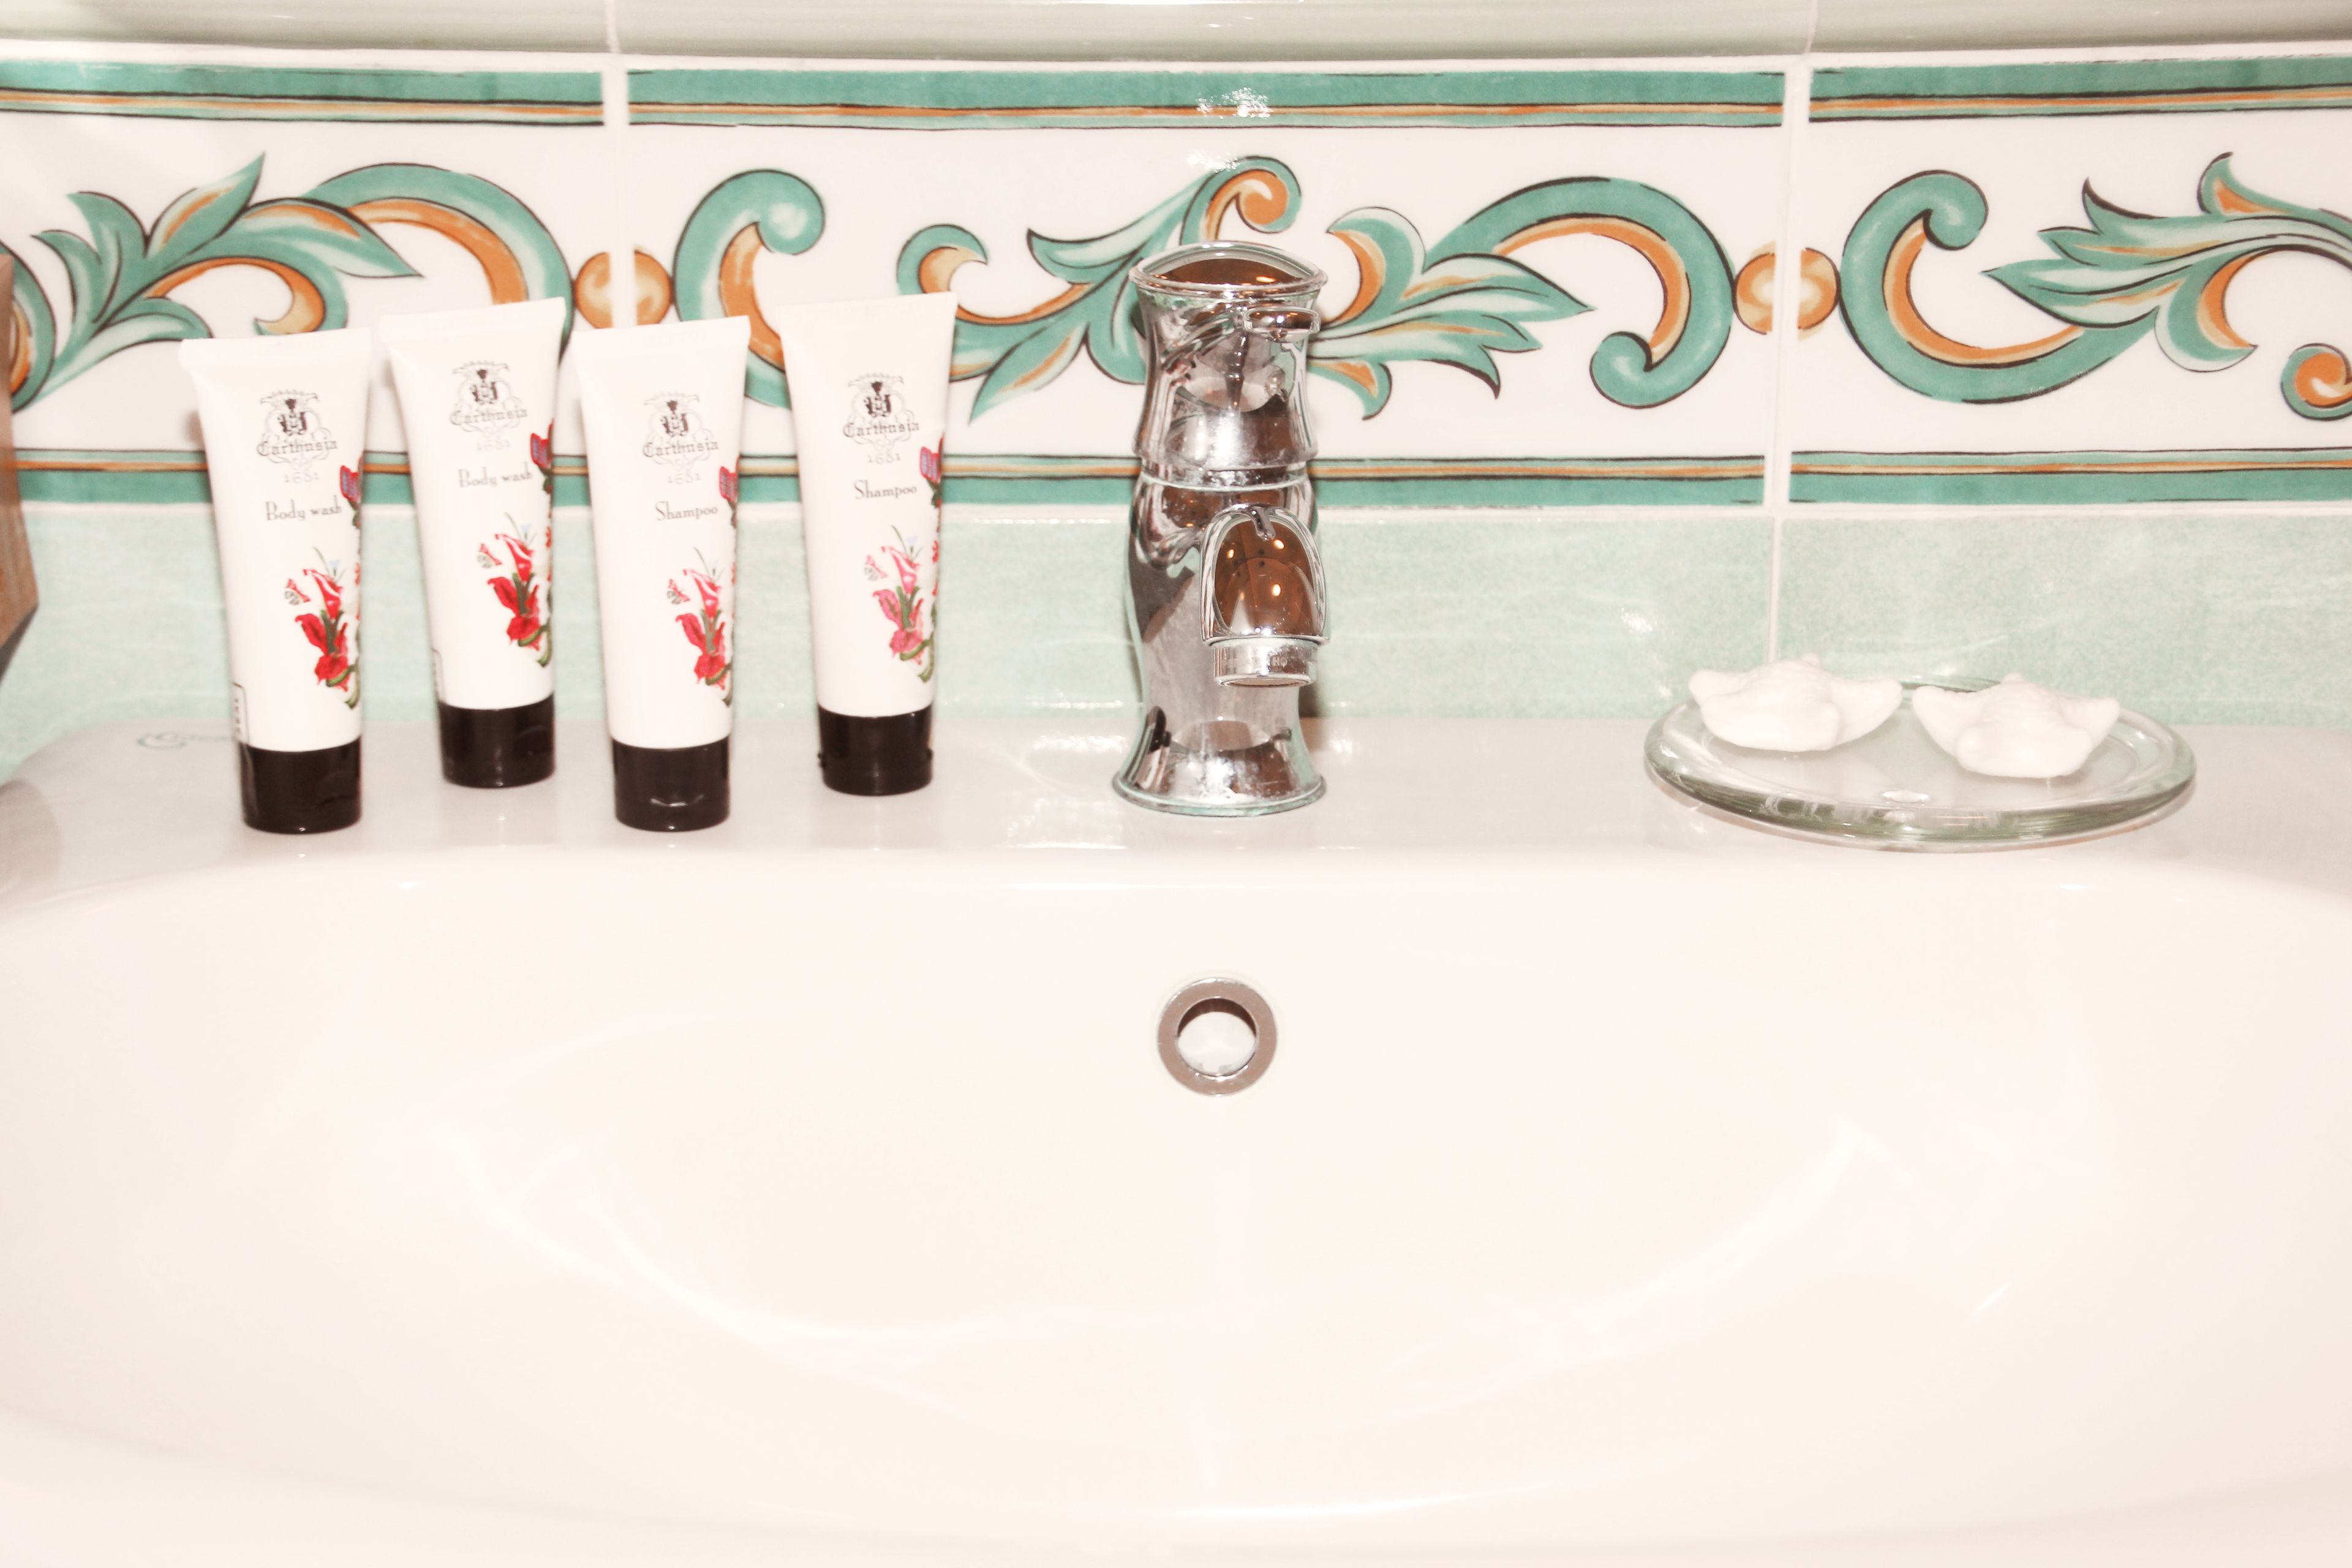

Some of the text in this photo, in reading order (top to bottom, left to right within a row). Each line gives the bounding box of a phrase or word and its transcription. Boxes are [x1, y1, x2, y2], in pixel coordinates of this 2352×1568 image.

[843, 419, 919, 438] Carthusia
[257, 437, 337, 456] Carthusia
[643, 437, 720, 458] Carthusia
[458, 461, 533, 488] Body wash
[853, 479, 918, 500] Shampoo
[265, 494, 342, 521] Body wash
[655, 500, 719, 521] Shampoo
